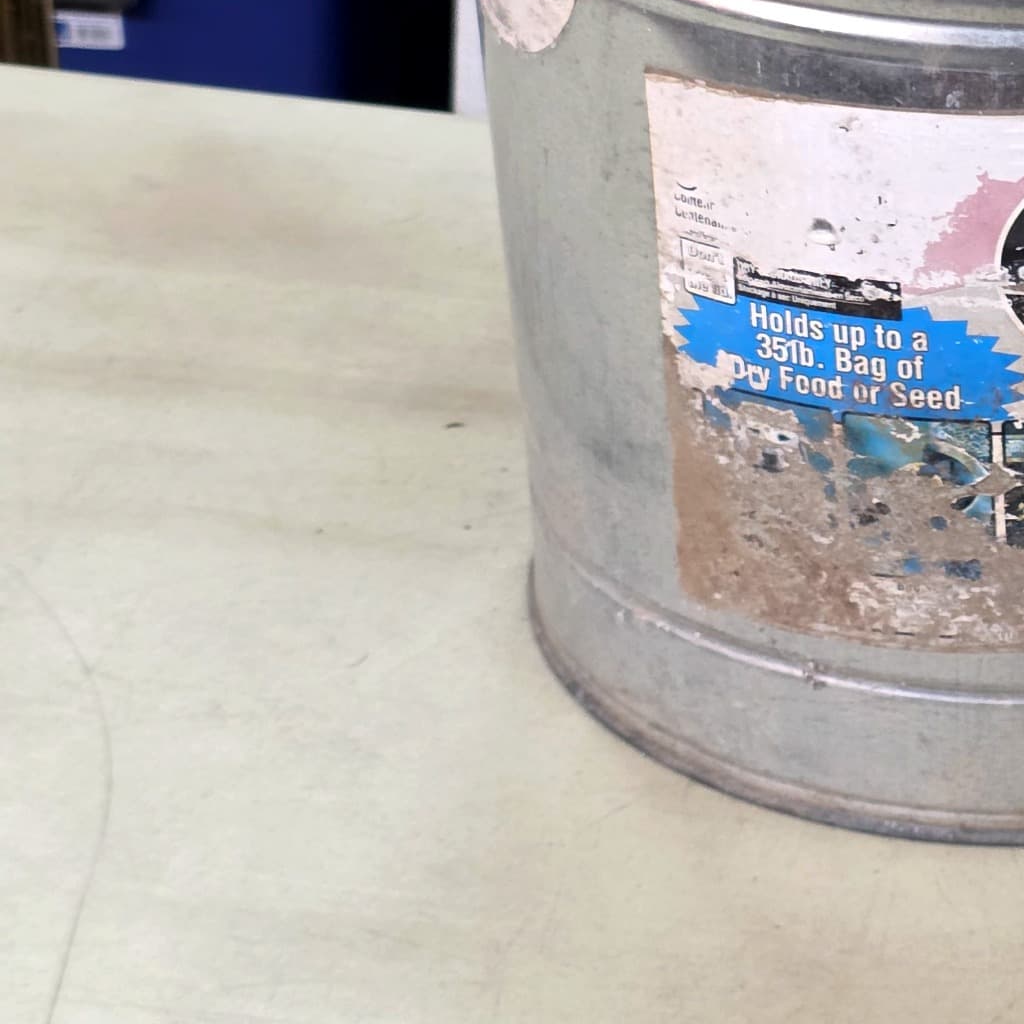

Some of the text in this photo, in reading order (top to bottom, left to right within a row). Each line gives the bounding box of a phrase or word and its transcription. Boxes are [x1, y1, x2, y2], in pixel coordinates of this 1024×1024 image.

[750, 302, 929, 352] Holds up to a
[731, 354, 961, 411] Dry Food or Seed
[835, 347, 887, 382] Bag
[897, 355, 924, 380] of
